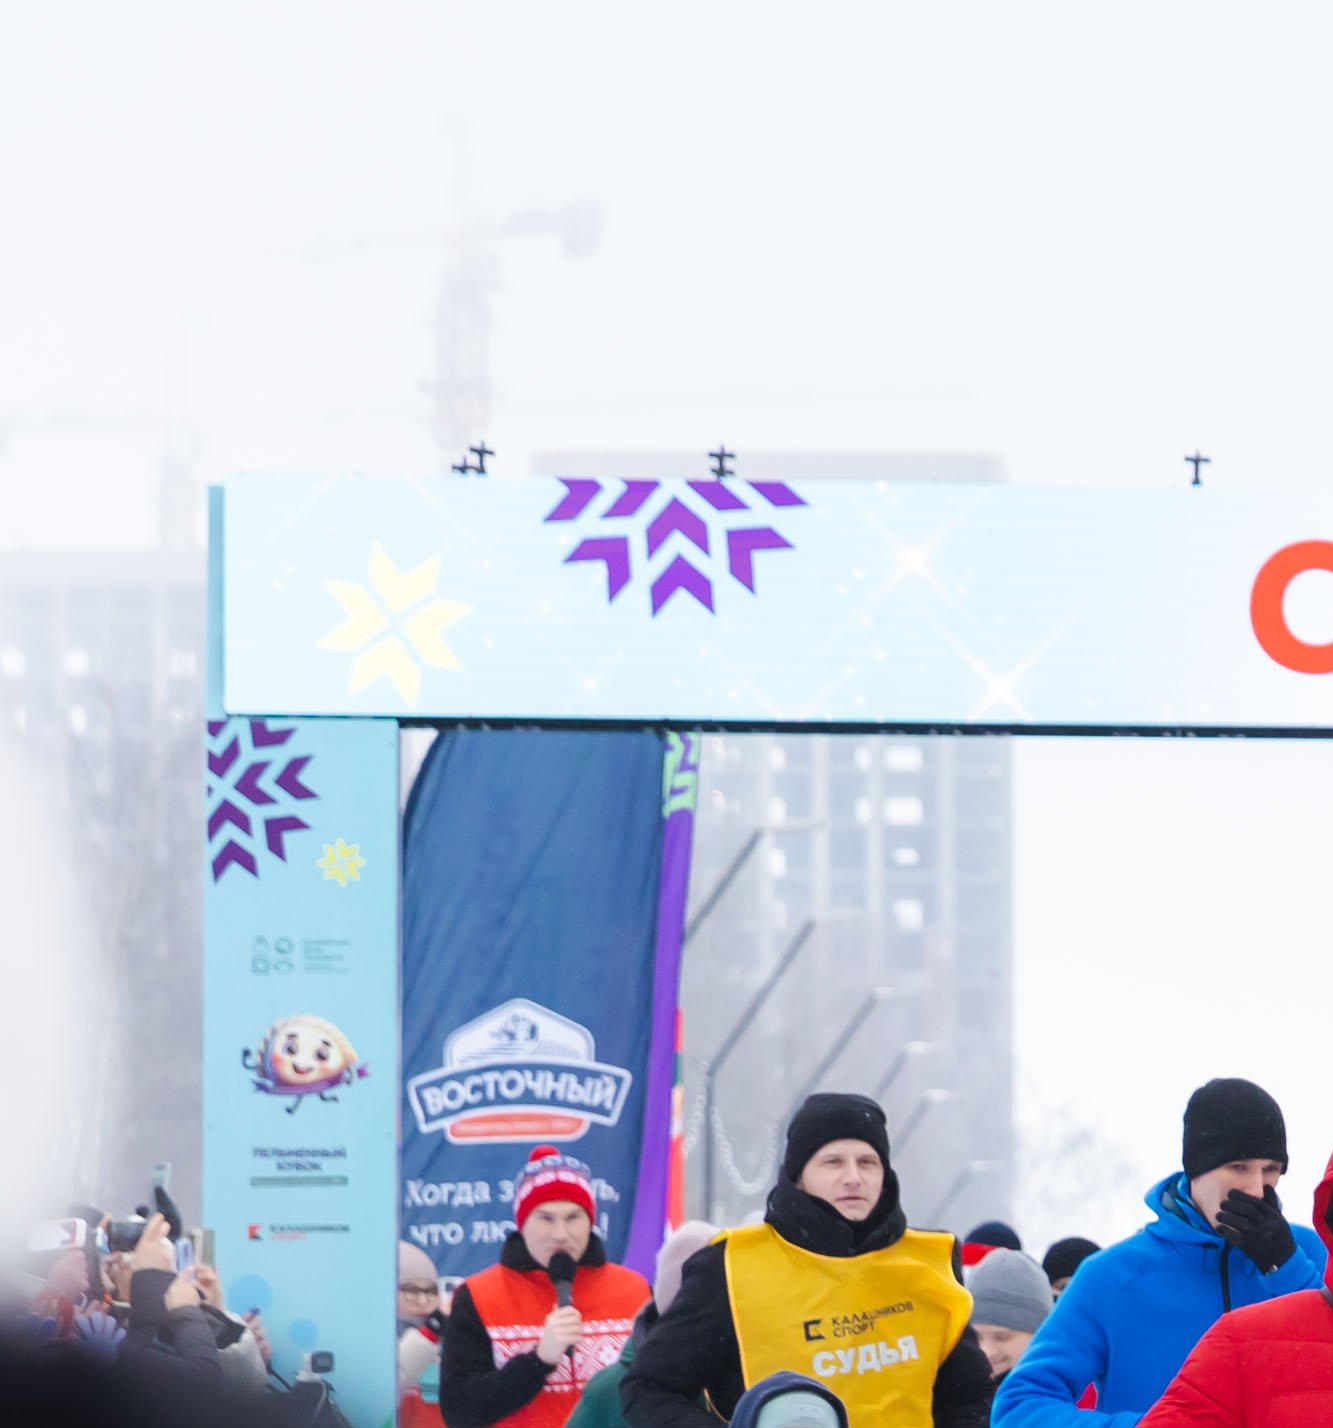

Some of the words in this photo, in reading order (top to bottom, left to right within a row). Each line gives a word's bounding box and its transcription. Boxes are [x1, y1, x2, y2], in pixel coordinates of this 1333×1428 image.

[420, 1070, 618, 1115] ВОСТОЧНЫЙ
[832, 1321, 876, 1339] СПОРТ
[812, 1335, 919, 1377] СУДЬЯ
